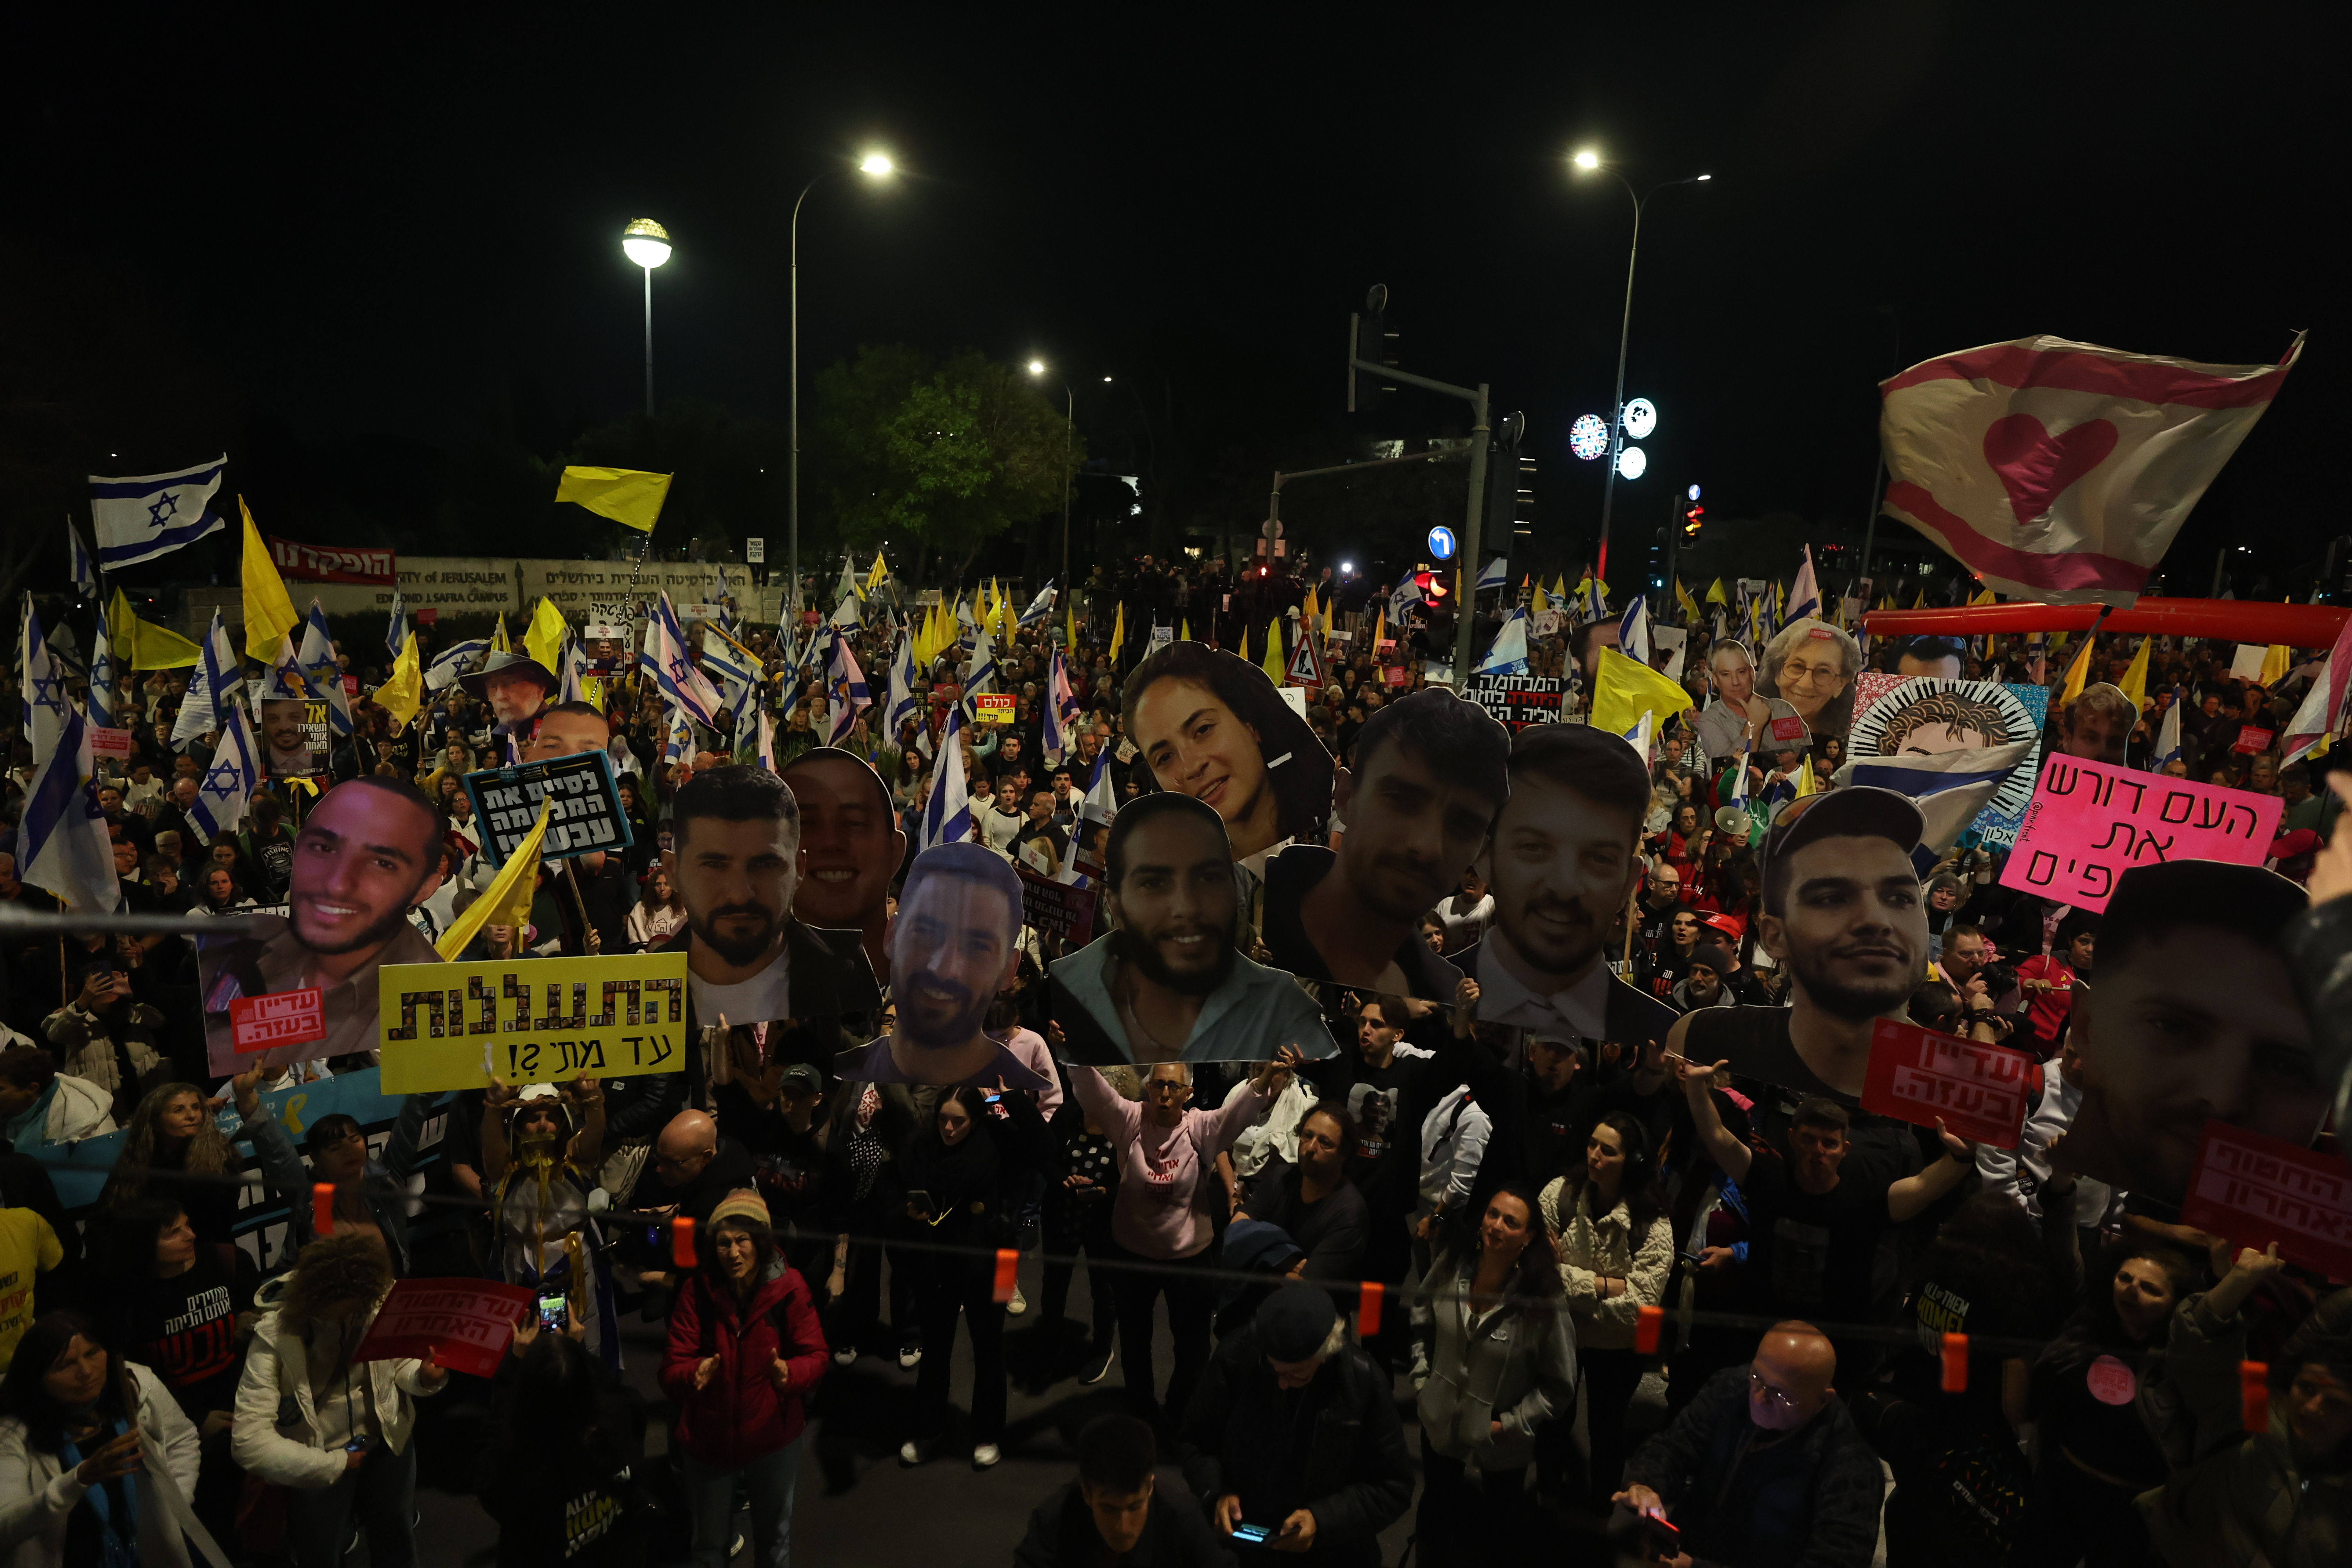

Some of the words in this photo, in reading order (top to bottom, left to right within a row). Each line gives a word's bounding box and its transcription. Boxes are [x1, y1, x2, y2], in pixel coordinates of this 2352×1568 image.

[276, 543, 390, 575] הופקרנו
[425, 572, 437, 583] of
[441, 572, 506, 584] JERUSALEM
[546, 571, 604, 584] בירושלים
[611, 573, 659, 584] העברית
[667, 574, 745, 586] האויברסיטה
[434, 593, 465, 603] SAFRA
[467, 592, 508, 603] CAMPUS
[548, 592, 578, 602] ספרא
[1479, 674, 1559, 692] המלחמה
[984, 696, 1010, 708] כולם
[1507, 691, 1562, 706] היחידה
[305, 702, 327, 724] אל
[1522, 707, 1560, 724] אליה
[1779, 718, 1797, 728] עדיין
[298, 723, 327, 733] תשאירו
[310, 732, 327, 741] אותי
[303, 741, 327, 750] מאחור
[483, 786, 524, 809] את
[525, 770, 599, 802] לסיים
[2046, 762, 2147, 814] דורש
[2160, 791, 2257, 839] העם
[496, 817, 616, 861] עכשו!
[1984, 828, 2014, 844] אלון
[2091, 822, 2174, 862] את
[264, 846, 291, 859] FISHING
[2026, 850, 2112, 898] פים
[259, 993, 315, 1018] עדיין
[388, 974, 682, 1040] התעללות
[247, 1015, 319, 1040] בעזה.
[550, 1040, 606, 1073] מתי
[622, 1034, 671, 1066] עד
[1924, 1039, 2021, 1084] עדיין
[1896, 1071, 2012, 1123] בעזה.
[1148, 1171, 1173, 1181] ואחיי
[2216, 1143, 2343, 1202] החטוף
[187, 1285, 229, 1312] מחזירים
[204, 1296, 231, 1321] אותם
[396, 1293, 478, 1310] החטוף
[483, 1296, 515, 1317] עד
[1924, 1281, 1939, 1301] ALL
[1942, 1289, 1970, 1318] THEM
[164, 1308, 203, 1335] הביתה
[394, 1315, 492, 1341] האחרון
[566, 1495, 614, 1540] HOM
